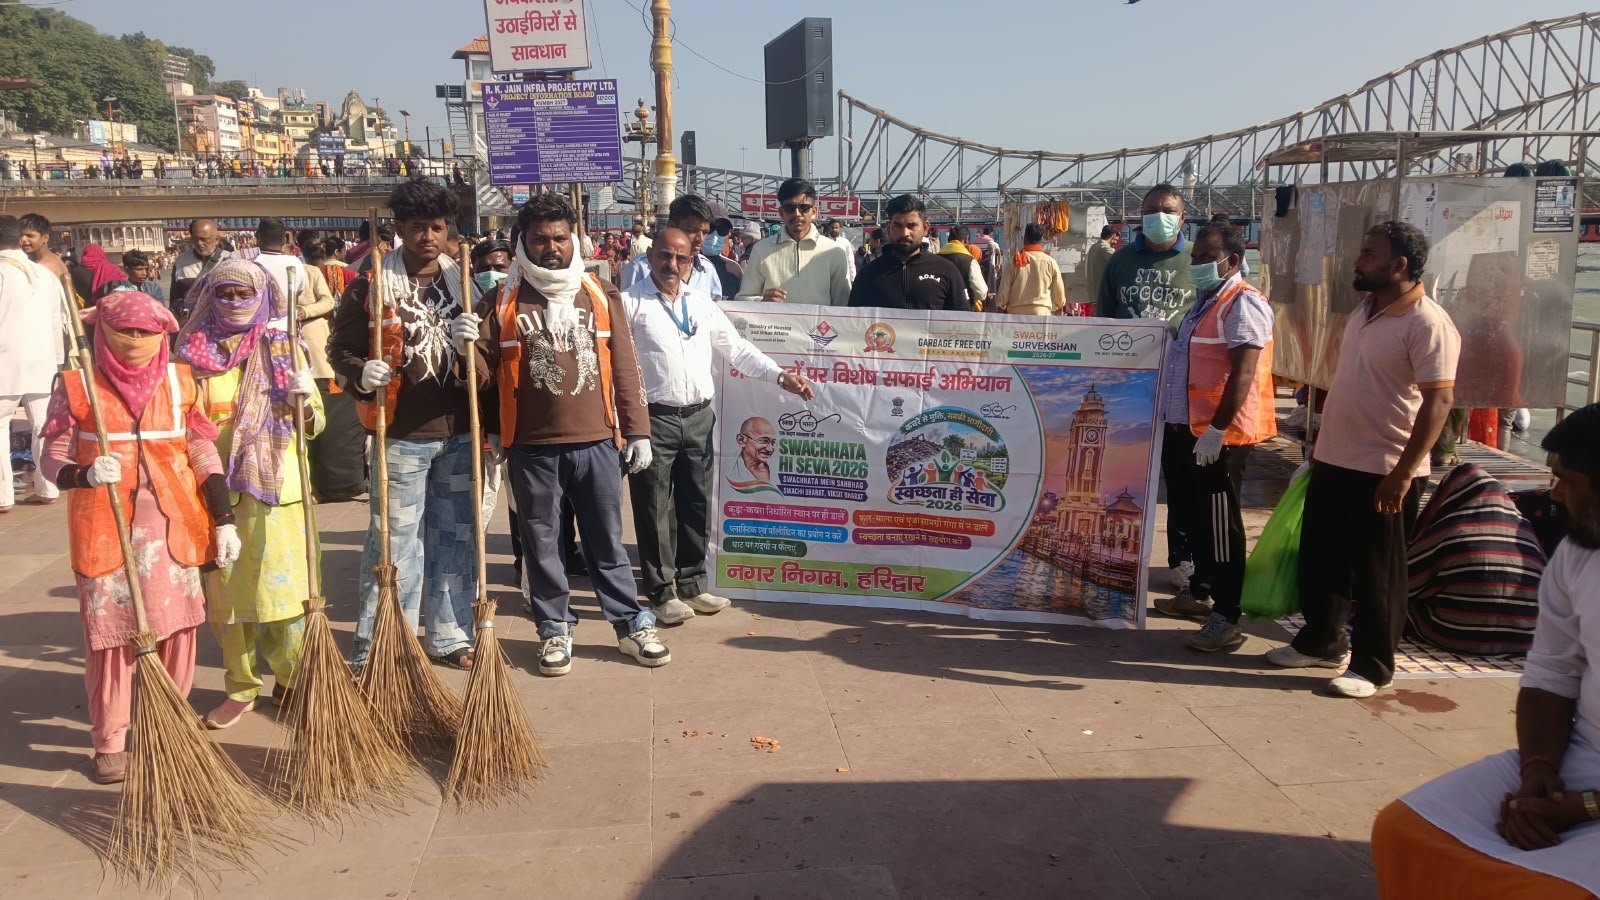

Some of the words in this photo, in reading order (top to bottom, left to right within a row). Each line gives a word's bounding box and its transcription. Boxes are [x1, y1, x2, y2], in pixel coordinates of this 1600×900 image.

[495, 10, 561, 34] उठाईगिरों
[563, 10, 577, 30] से
[511, 44, 566, 60] सावधान
[486, 86, 492, 94] R.
[504, 85, 521, 94] JAIN
[524, 84, 546, 93] INFRA
[548, 83, 581, 92] PROJECT
[583, 82, 597, 91] PVT
[600, 82, 615, 90] LTD.
[1136, 268, 1177, 284] STAY
[1120, 286, 1191, 308] SPOOKY
[516, 308, 595, 336] DIEL
[1013, 331, 1057, 340] SWACHH
[918, 338, 952, 348] GARBAGE
[954, 340, 973, 349] FREE
[976, 340, 992, 350] CITY
[1012, 341, 1077, 351] SURVEKSHAN
[806, 366, 829, 384] पर
[832, 361, 878, 386] विशेष
[882, 366, 937, 392] सफाई
[938, 368, 1013, 393] अभियान
[922, 413, 929, 422] से
[779, 438, 867, 461] SWACHHATA
[779, 456, 793, 472] HI
[796, 457, 831, 475] SEVA
[831, 460, 869, 479] 2026
[782, 475, 818, 485] SWACHHATA
[820, 478, 835, 486] MEIN
[895, 486, 948, 501] स्वच्छता
[949, 486, 964, 502] ही
[966, 488, 997, 507] सेवा
[926, 500, 962, 511] 2026
[794, 510, 810, 518] स्थान
[821, 510, 829, 520] ही
[726, 564, 777, 583] नगर
[780, 560, 849, 588] निगम,
[856, 566, 926, 592] हरिद्वार
